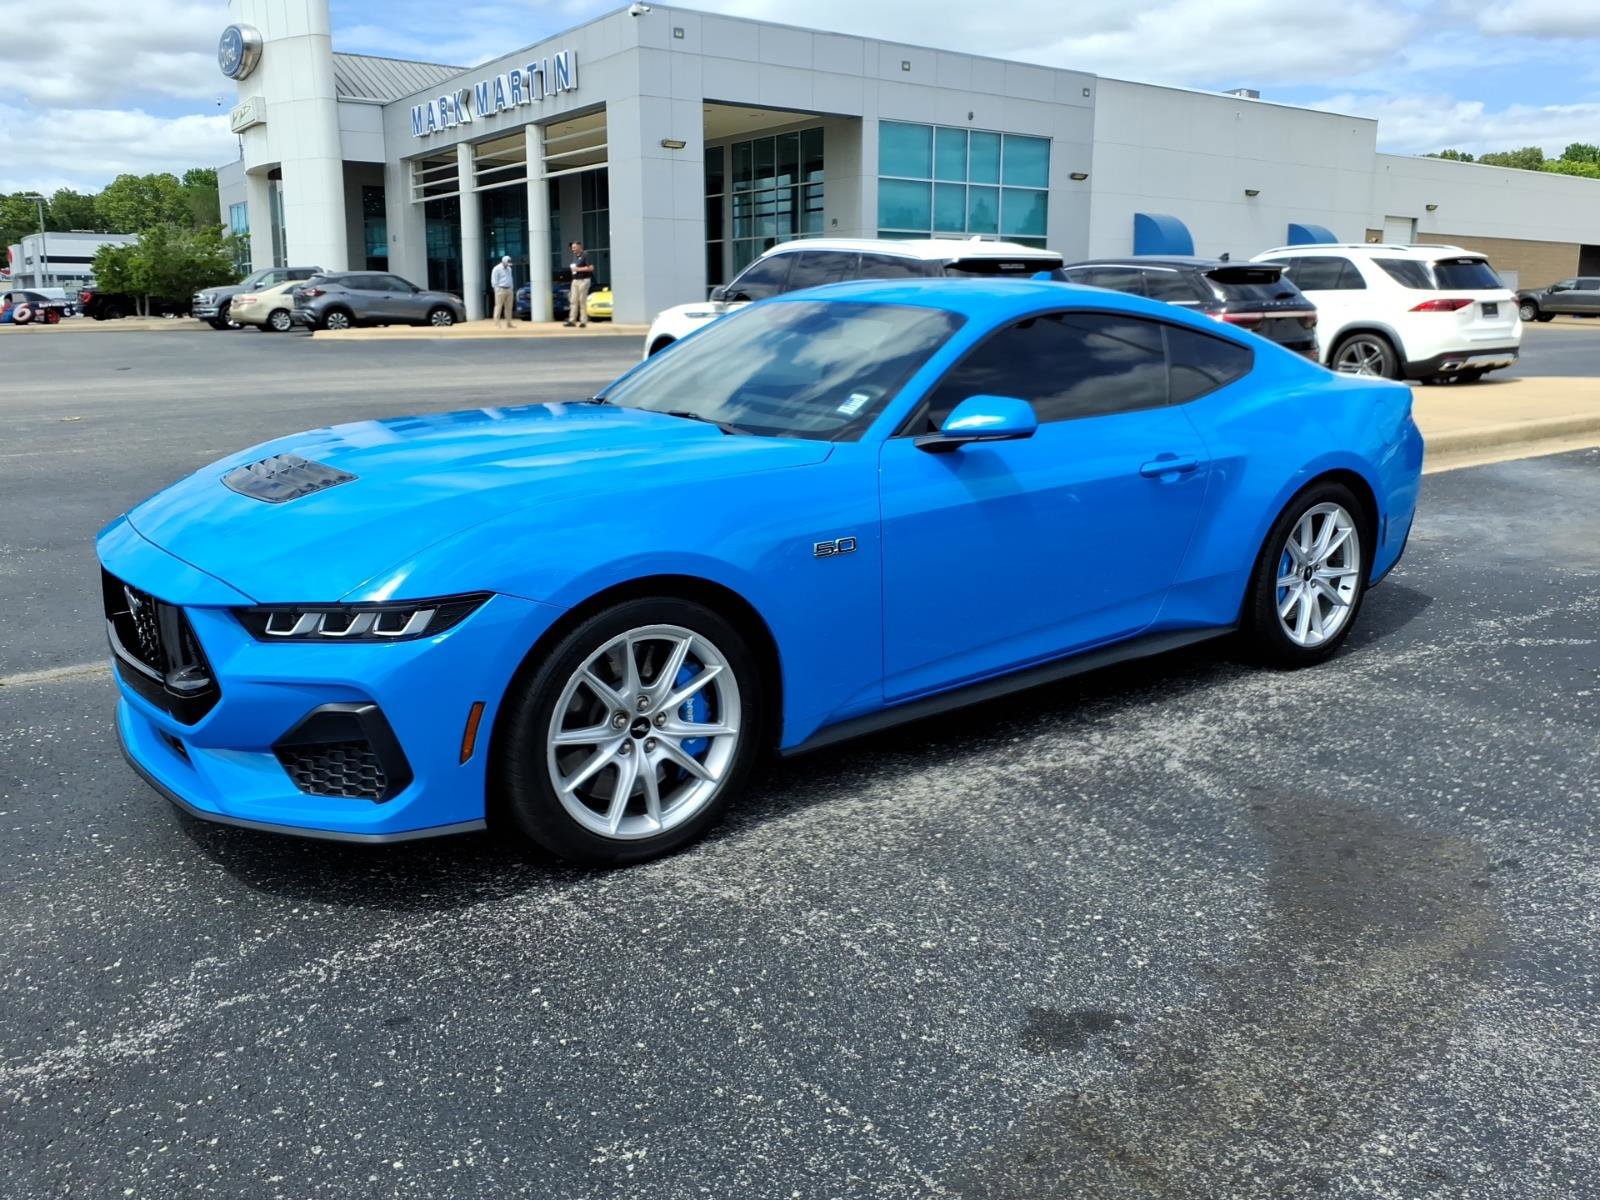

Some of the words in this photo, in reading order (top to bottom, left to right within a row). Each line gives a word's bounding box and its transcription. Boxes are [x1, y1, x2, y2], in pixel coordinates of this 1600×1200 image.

[219, 32, 238, 68] Ford
[411, 89, 471, 138] MARK
[474, 50, 577, 117] MARTIN
[813, 537, 856, 557] 5.0
